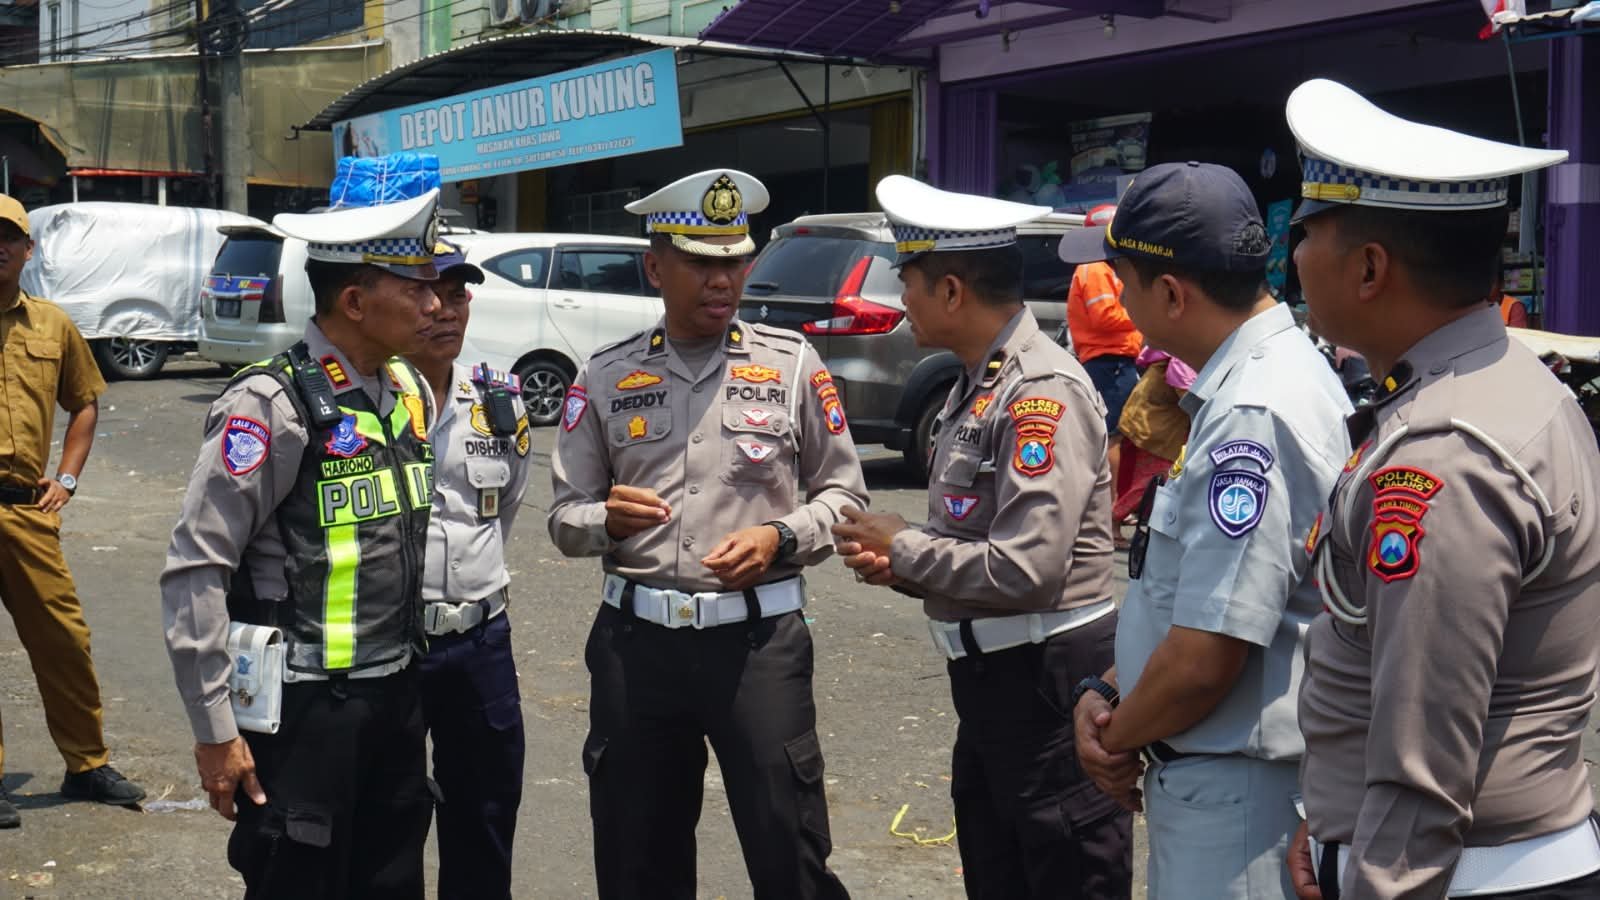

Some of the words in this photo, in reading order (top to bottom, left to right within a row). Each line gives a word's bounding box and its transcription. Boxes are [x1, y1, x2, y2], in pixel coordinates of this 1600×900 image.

[400, 102, 465, 150] DEPOT
[471, 86, 546, 139] JANUR
[551, 62, 656, 123] KUNING
[476, 139, 513, 154] MASAKAN
[515, 134, 537, 147] KHAS
[538, 130, 561, 144] JAWA
[1119, 236, 1136, 248] JASA
[1137, 240, 1174, 258] RAHARJA
[611, 390, 667, 413] DEDDY
[727, 386, 786, 404] POLRI
[320, 406, 334, 416] 12
[1014, 399, 1060, 411] POLRES
[231, 419, 250, 429] LALU
[465, 441, 509, 456] DISHUB
[1215, 444, 1249, 461] WILAYAH
[323, 458, 372, 476] HARIONO
[1216, 476, 1232, 487] JASA
[1376, 471, 1435, 489] POLRES
[1384, 480, 1424, 491] MALANG
